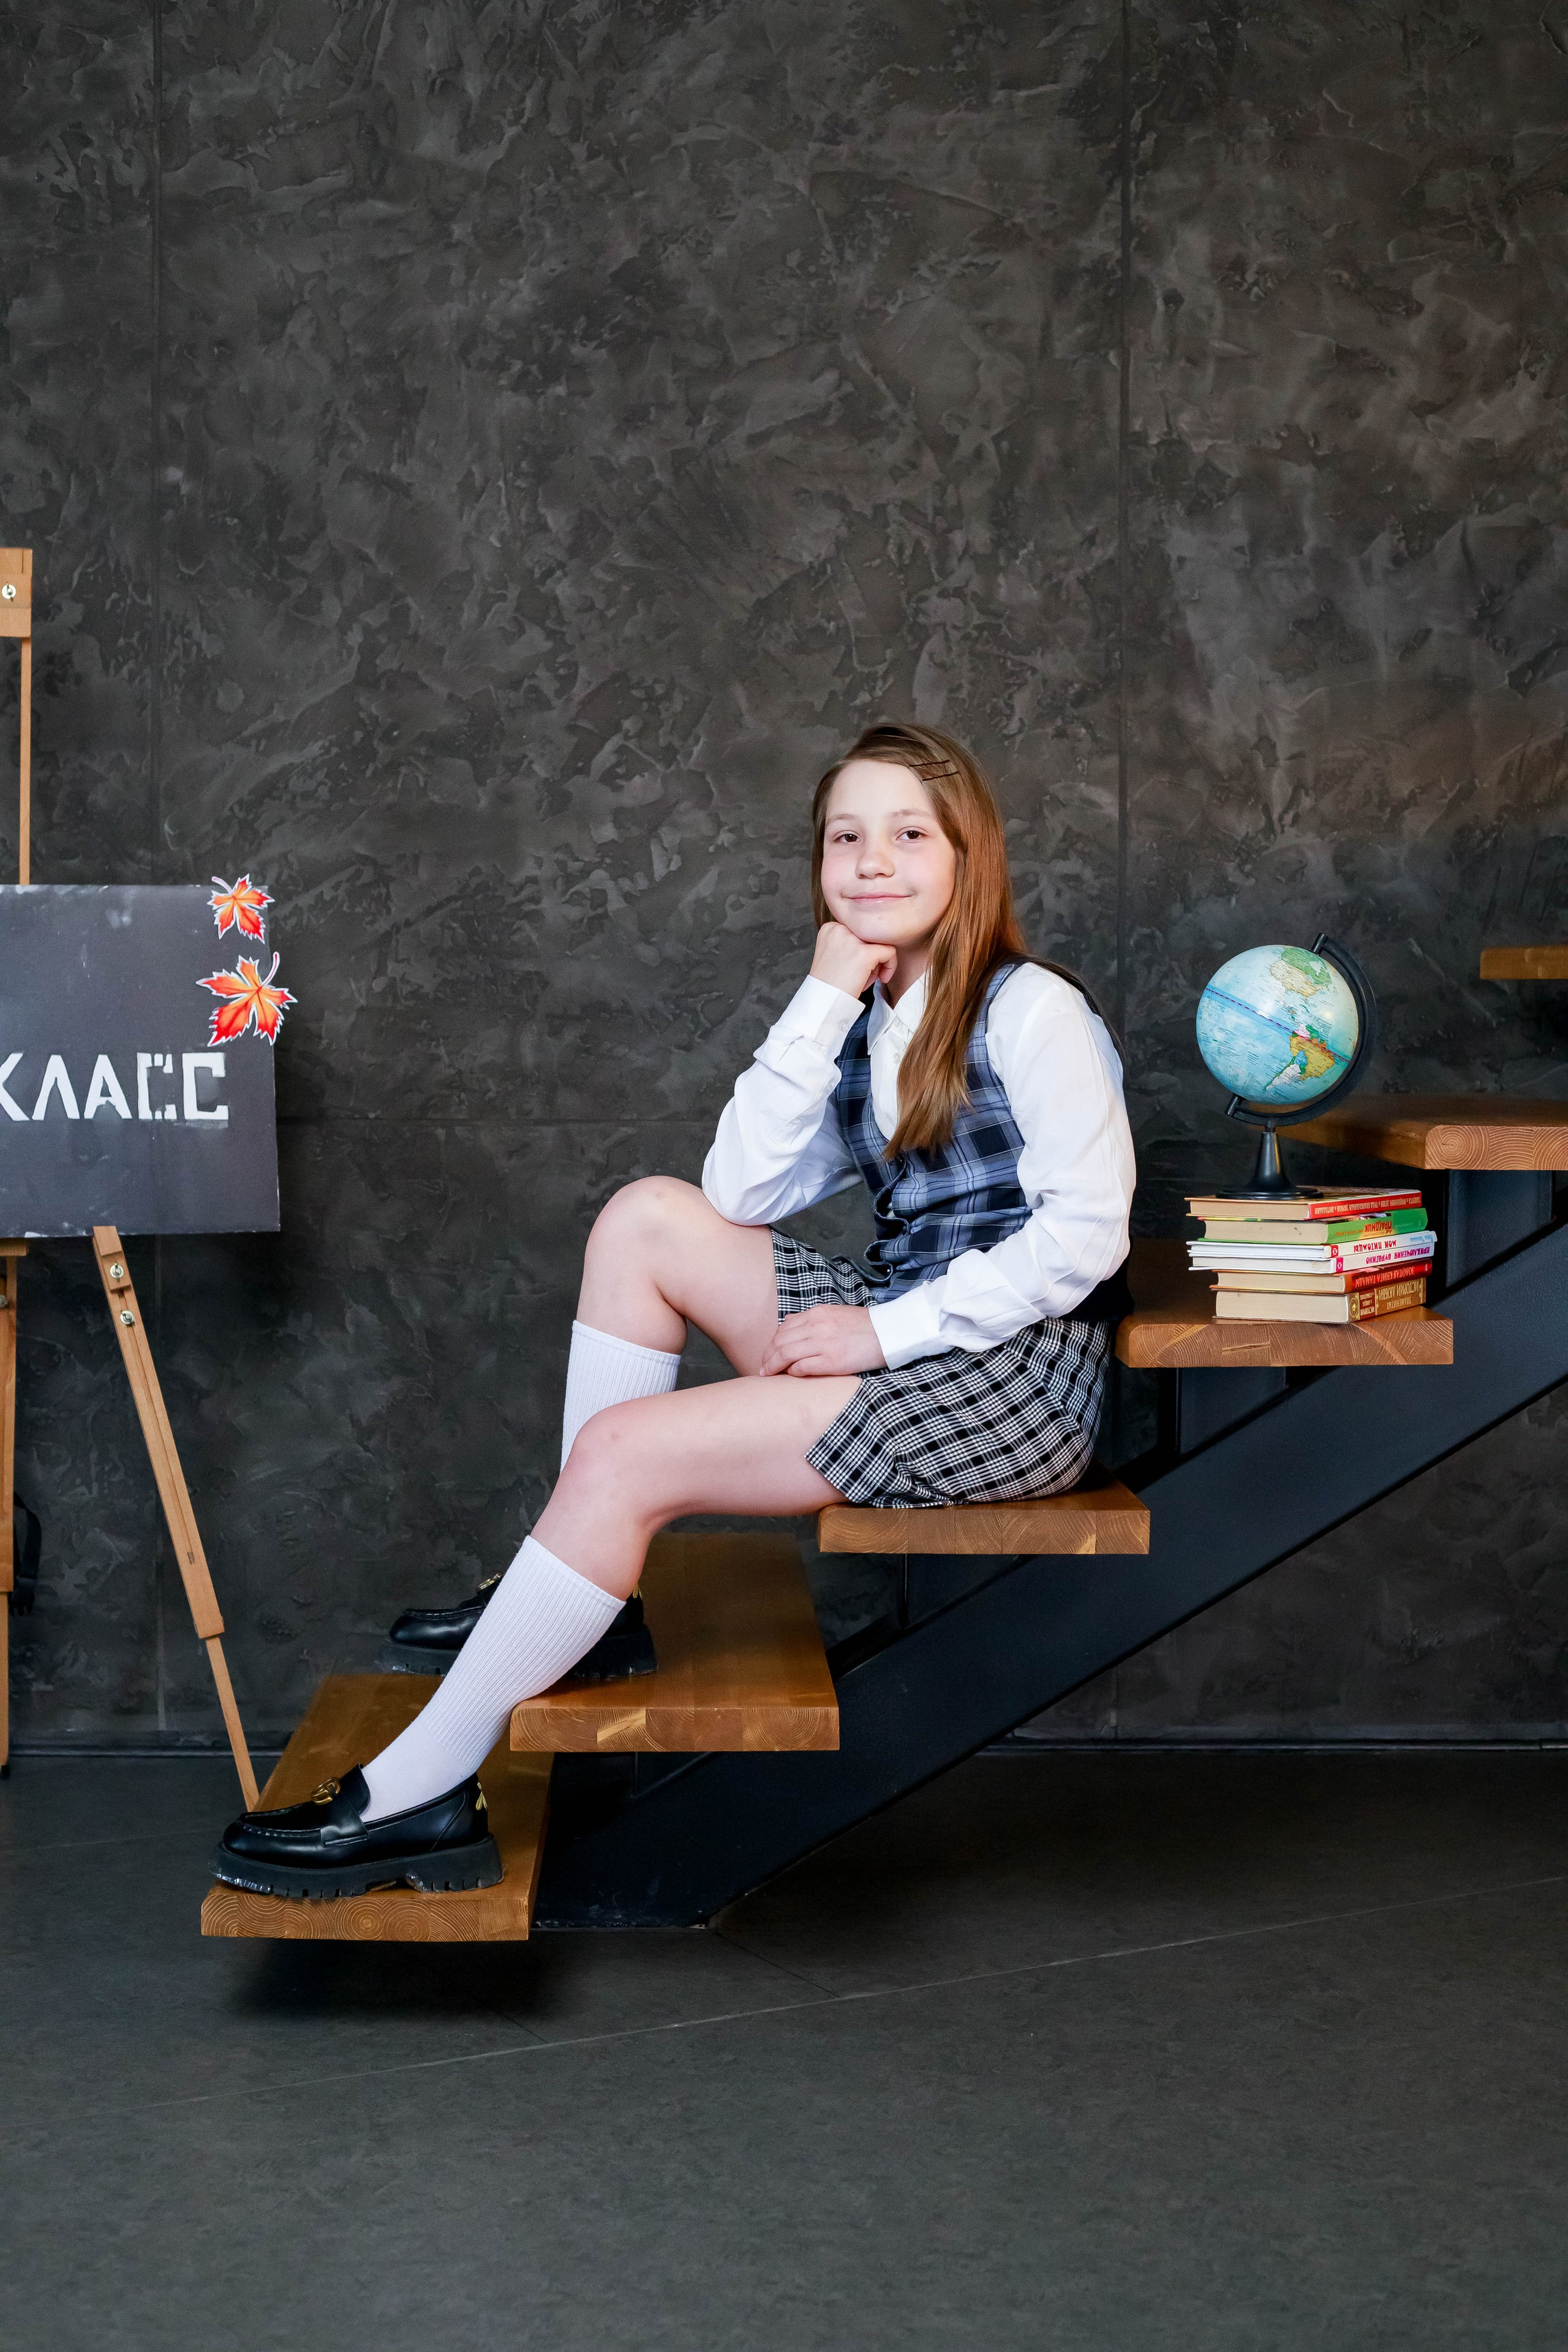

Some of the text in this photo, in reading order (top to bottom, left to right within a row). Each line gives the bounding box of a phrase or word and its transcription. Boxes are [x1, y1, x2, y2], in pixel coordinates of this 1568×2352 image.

[1364, 1220, 1392, 1232] ПРАЗДНИК
[1354, 1242, 1382, 1253] ПИТОМЦЫ
[1366, 1246, 1430, 1265] ПРИКЛЮЧЕНИЯ БУРАТИНО
[1355, 1266, 1415, 1287] ЗОЛОТАЯ КНИГА ТАМАДЫ
[1379, 1281, 1419, 1300] ИСТОРИИ ЛЮБВИ
[1387, 1297, 1411, 1310] ЗНАМЕНИТЫЕ
